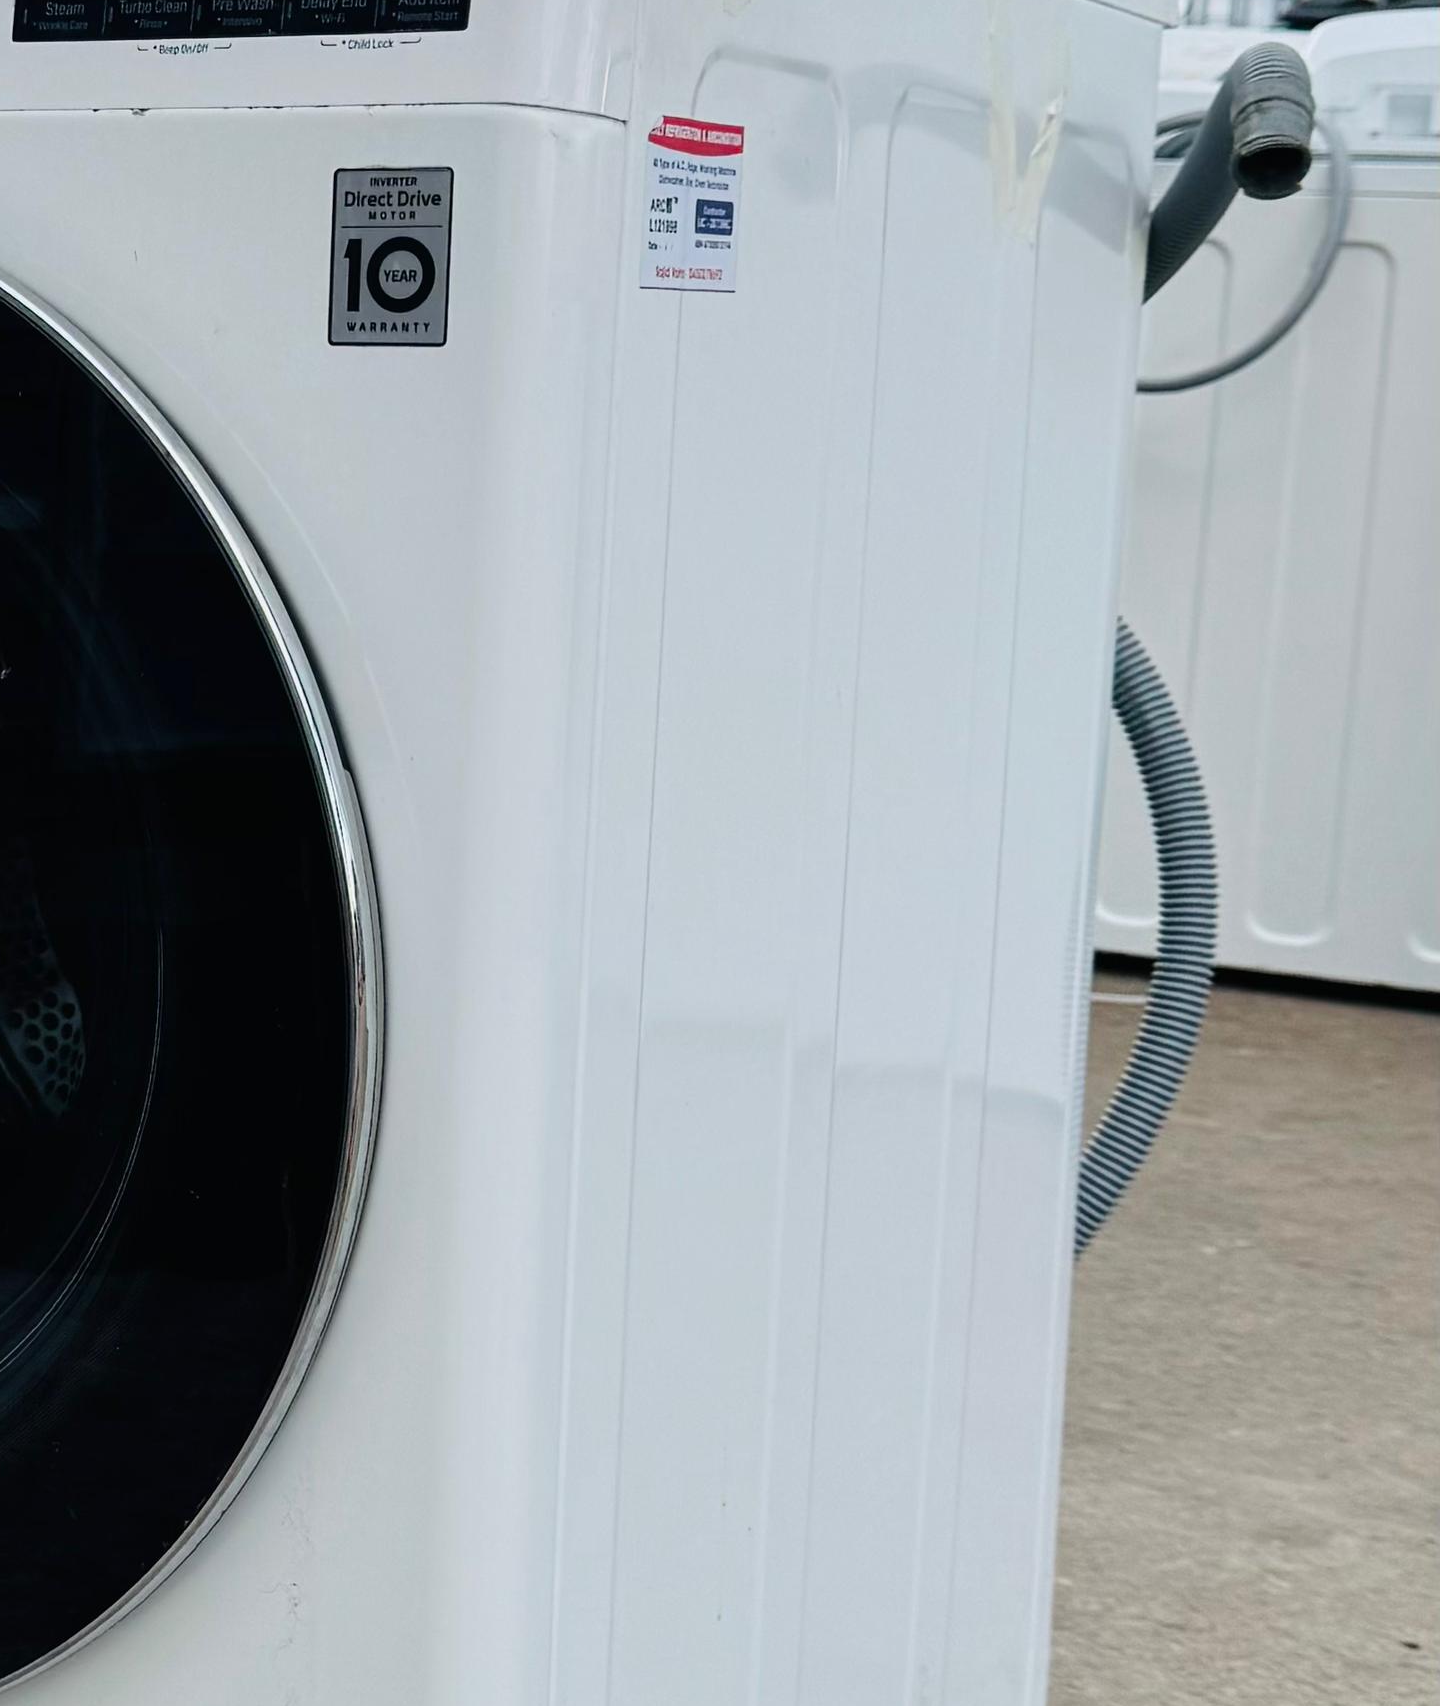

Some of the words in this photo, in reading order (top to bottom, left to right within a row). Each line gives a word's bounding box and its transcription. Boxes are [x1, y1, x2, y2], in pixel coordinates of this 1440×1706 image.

[45, 0, 85, 17] Steam
[369, 176, 417, 188] INVERTER
[343, 190, 394, 208] Direct
[397, 191, 442, 208] Drive
[368, 210, 417, 221] MOTOR
[343, 235, 436, 314] 10
[383, 268, 417, 284] YEAR
[346, 321, 431, 334] WARRANTY
